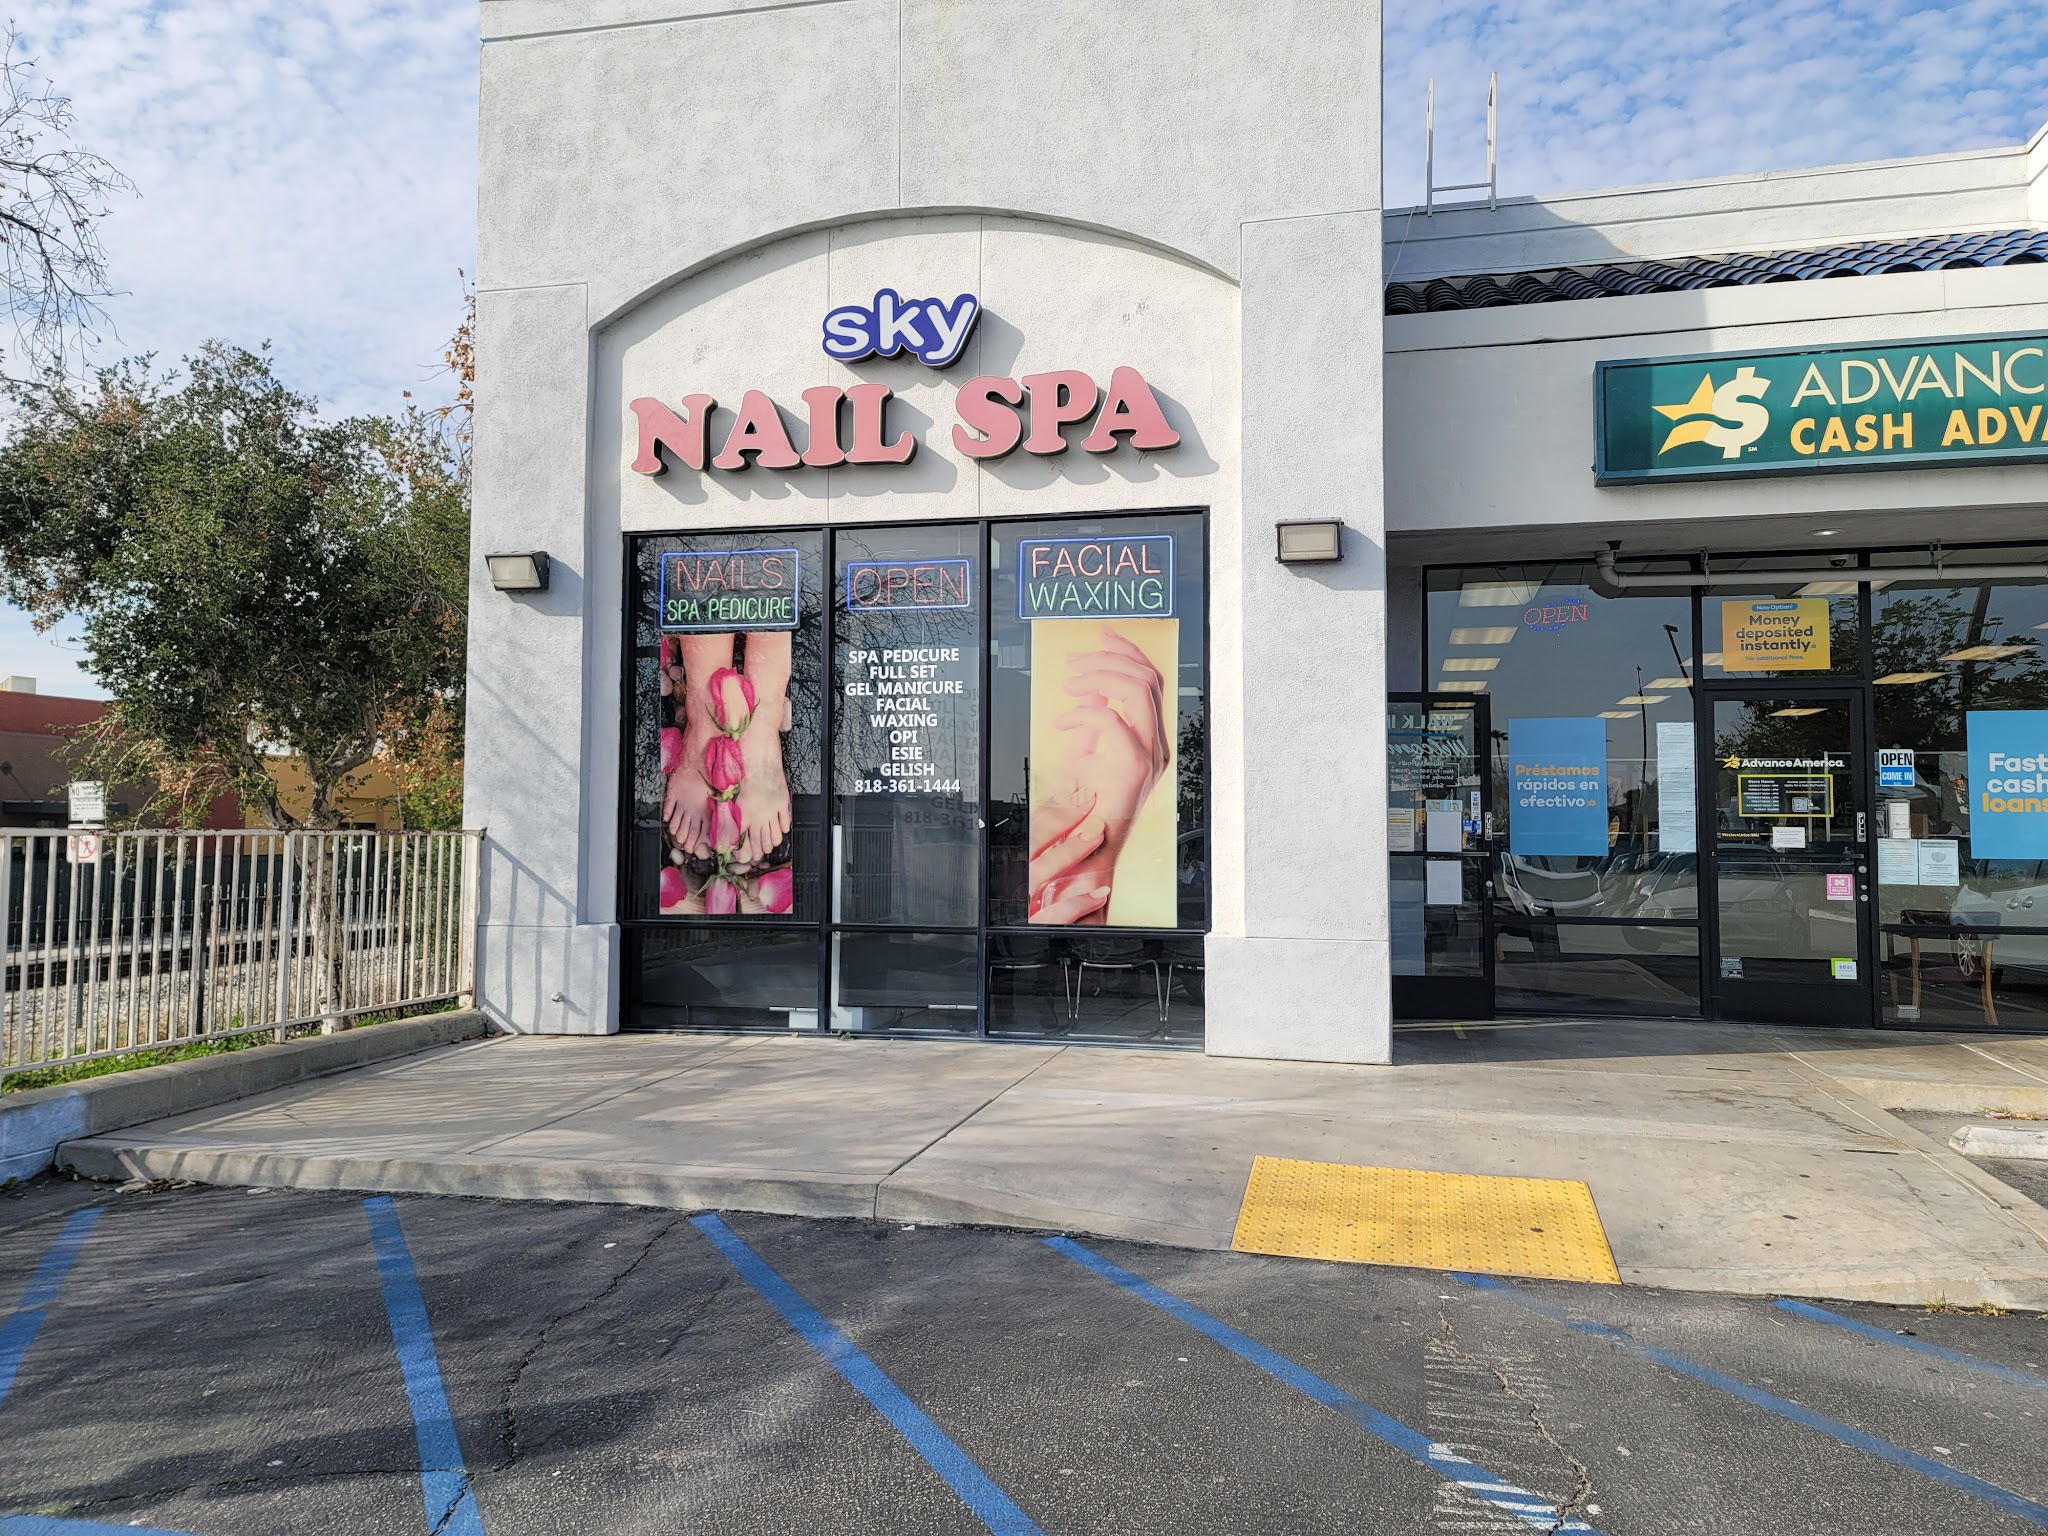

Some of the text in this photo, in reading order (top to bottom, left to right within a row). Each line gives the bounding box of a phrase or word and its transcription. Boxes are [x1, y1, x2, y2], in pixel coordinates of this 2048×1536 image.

[822, 288, 980, 368] sky
[630, 365, 1181, 474] NAIL SPA
[1790, 404, 2048, 455] CASH ADV
[1031, 544, 1161, 578] FACIAL
[676, 557, 784, 591] NAILS
[853, 566, 965, 605] OPEN
[1028, 578, 1163, 612] WAXING
[667, 596, 793, 621] SPA PEDICURE
[1523, 604, 1589, 626] OPEN
[1770, 603, 1794, 611] Option!
[1749, 614, 1801, 628] Money
[1735, 625, 1814, 642] deposited
[1740, 638, 1811, 653] instantly
[848, 648, 960, 664] SPA PEDICURE
[869, 665, 938, 680] FULL SET
[845, 680, 964, 696] GEL MANICURE
[876, 698, 931, 711] FACIAL
[870, 713, 938, 728] WAXING
[889, 730, 918, 744] OPI
[891, 746, 923, 760] ESIE
[1881, 753, 1913, 766] OPEN
[880, 762, 935, 777] GELISH
[1515, 764, 1600, 776] Préstamos
[1989, 752, 2048, 772] Fast
[1882, 771, 1912, 780] COME IN
[1986, 773, 2048, 793] cash
[854, 779, 961, 793] 818-361-1444
[1516, 778, 1599, 794] rápidos en
[1520, 795, 1586, 807] efectivo
